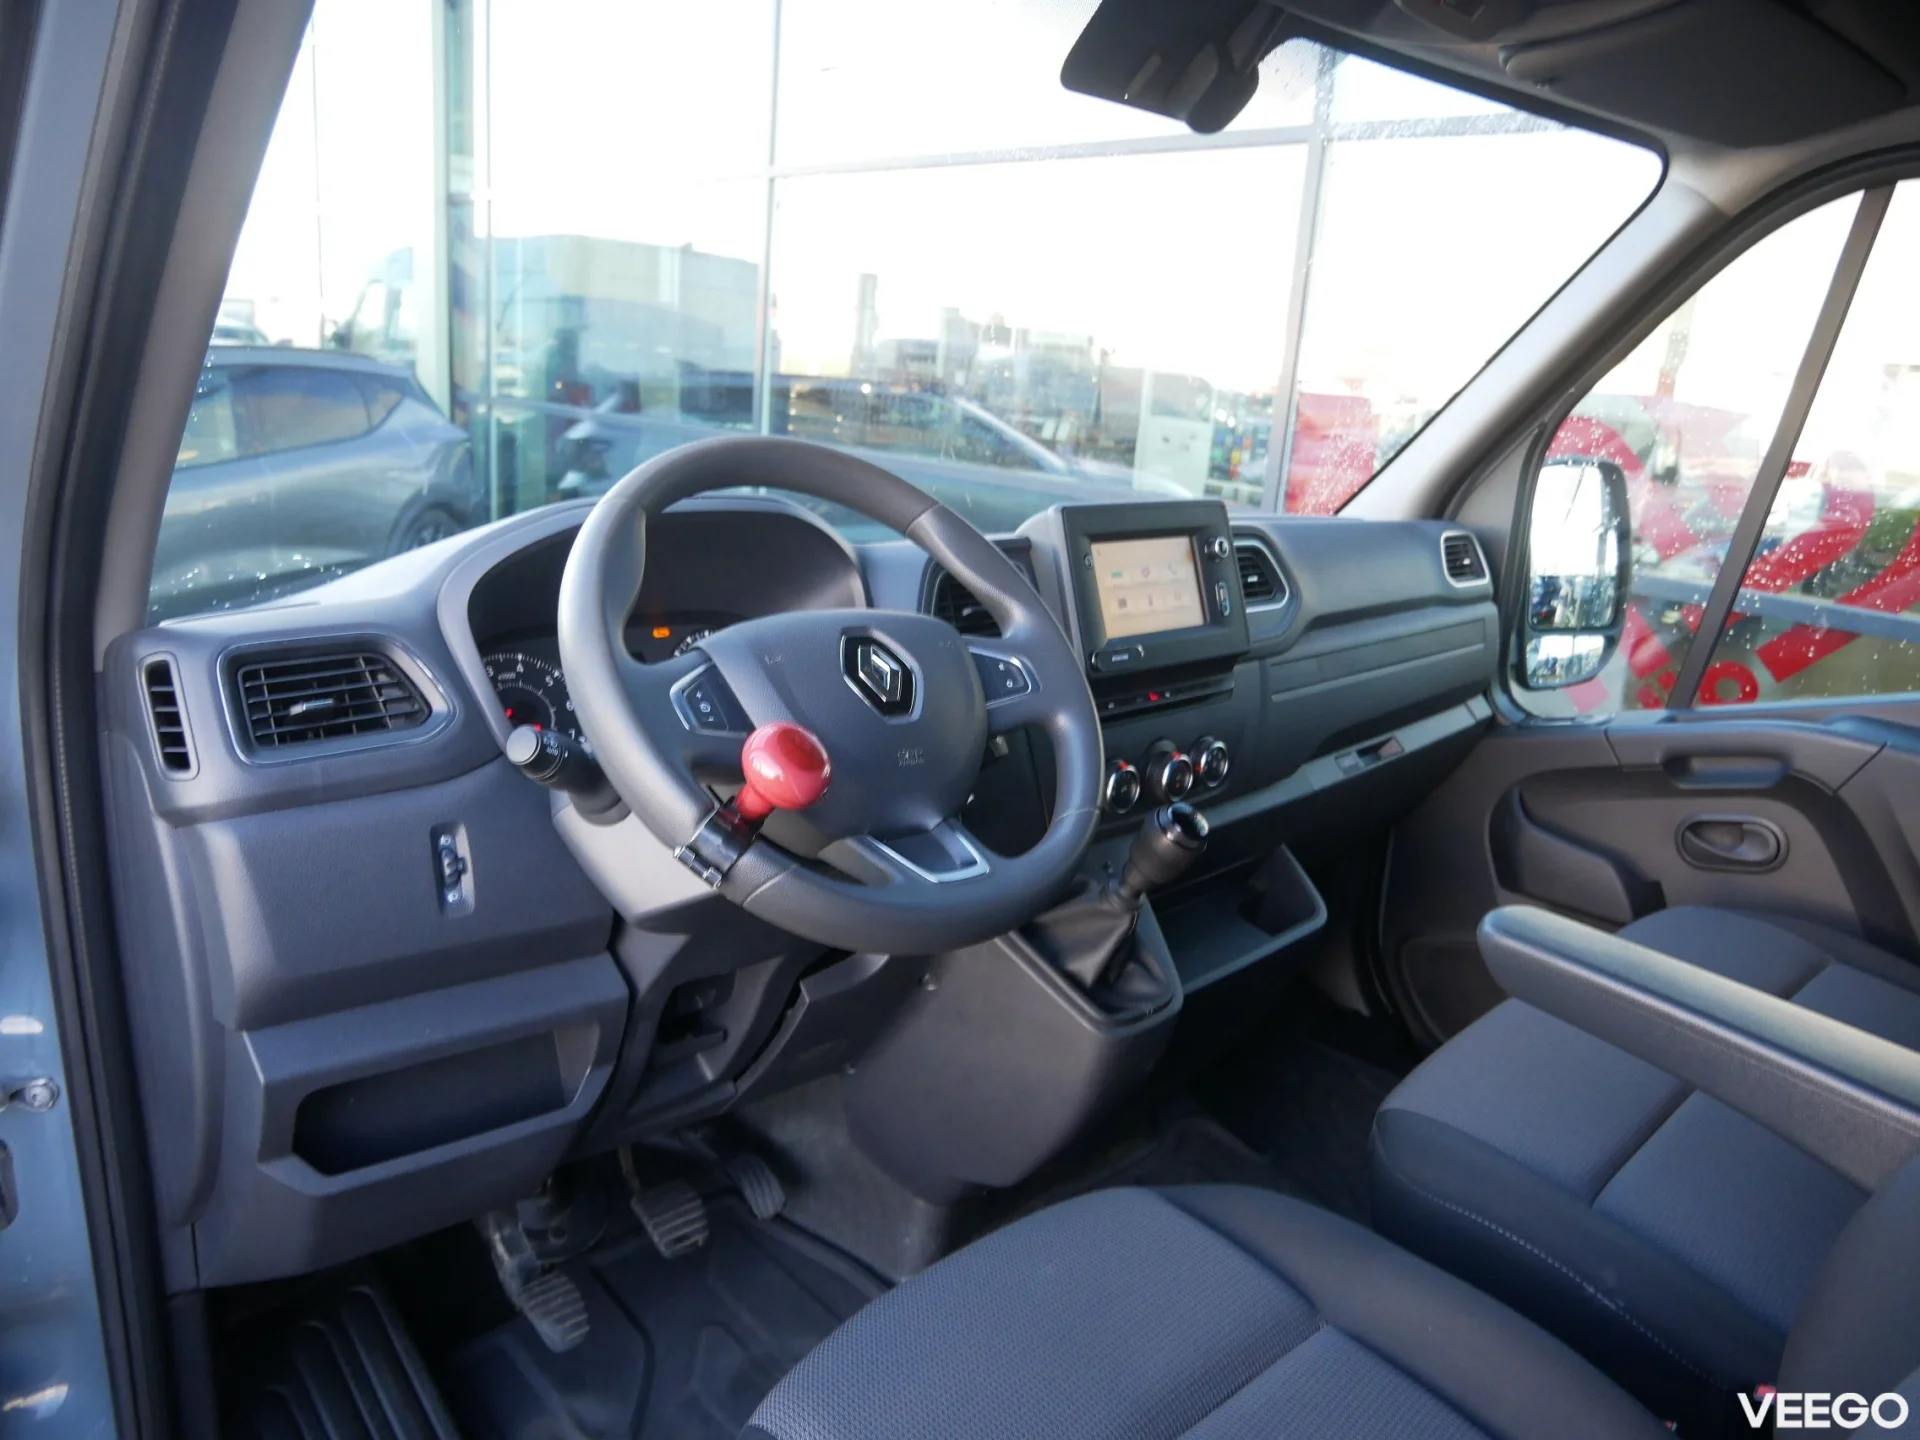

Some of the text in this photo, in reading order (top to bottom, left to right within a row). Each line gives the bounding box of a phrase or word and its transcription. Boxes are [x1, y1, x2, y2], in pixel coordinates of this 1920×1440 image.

[516, 662, 525, 674] 4
[545, 674, 554, 688] 5
[565, 700, 575, 712] 6
[567, 728, 576, 740] 7
